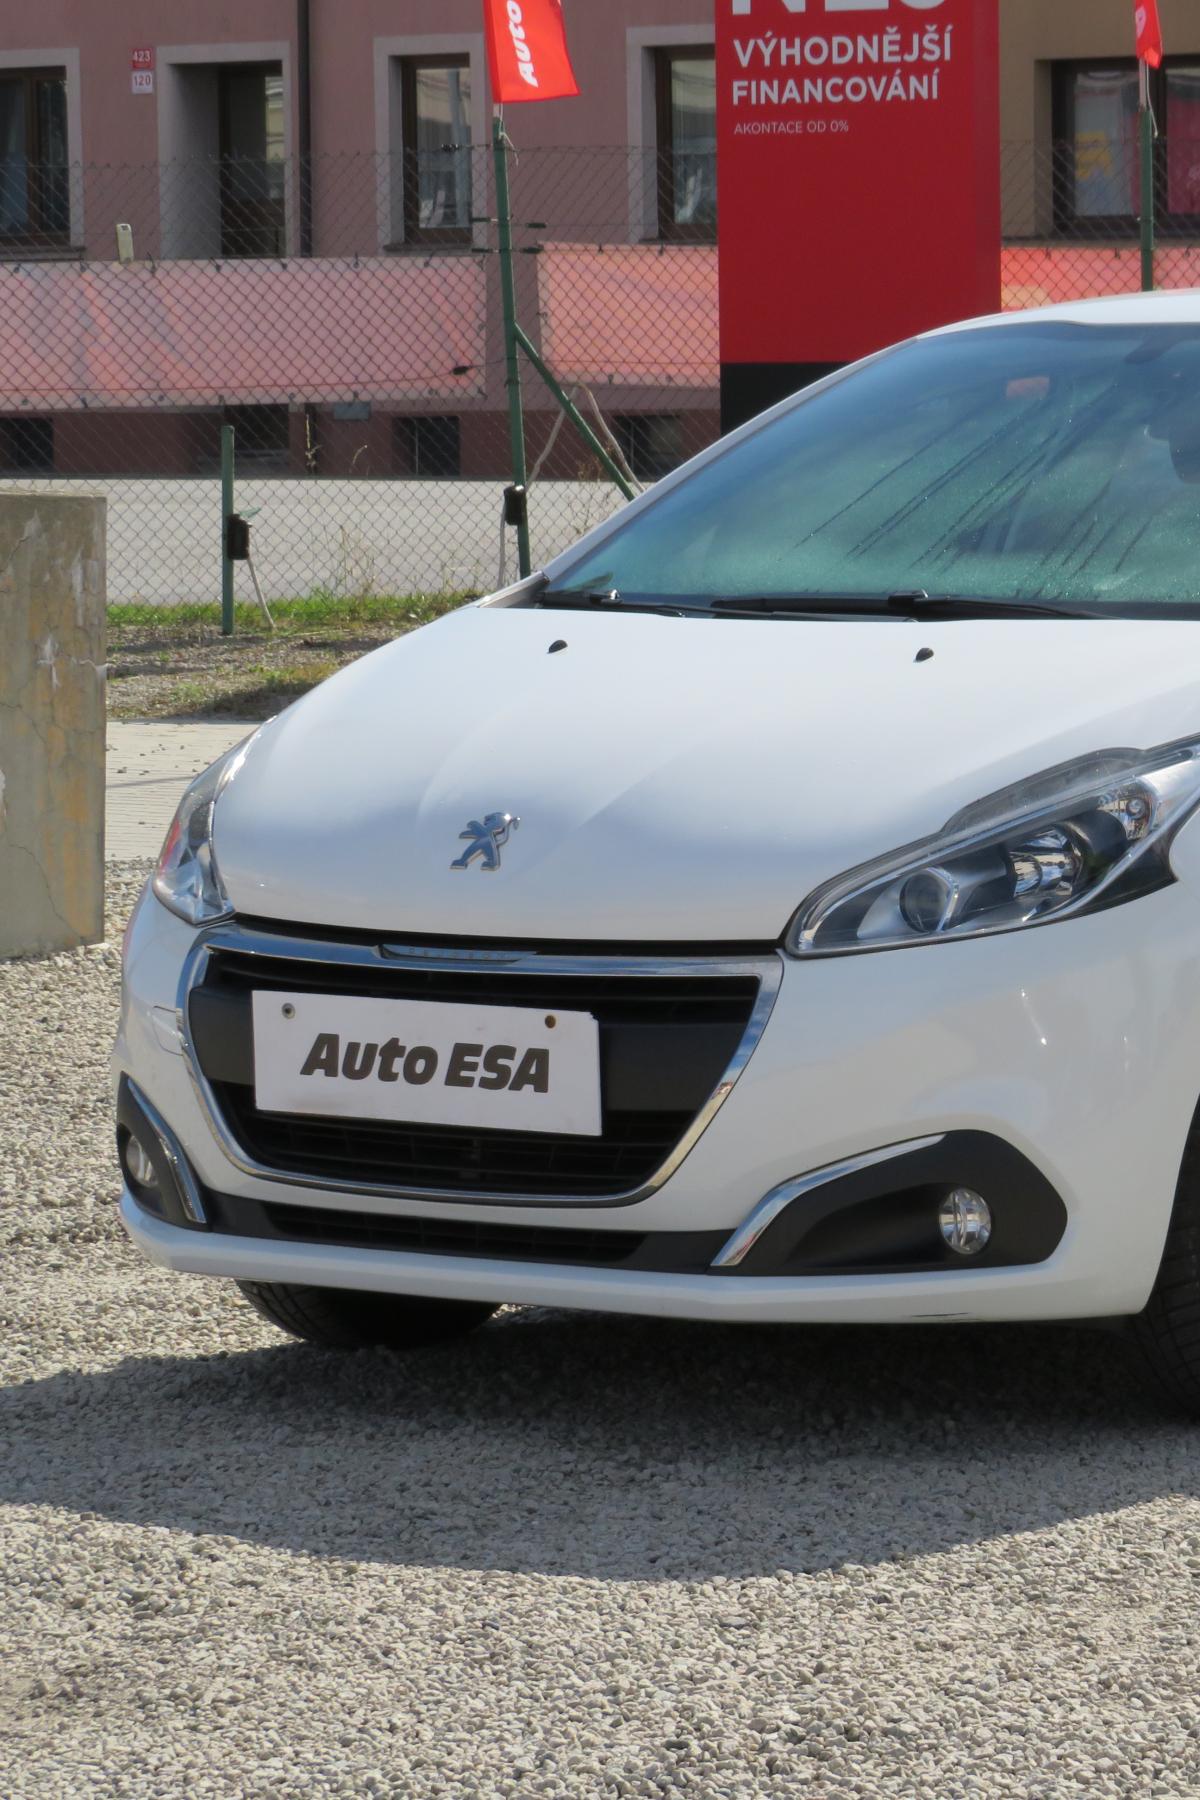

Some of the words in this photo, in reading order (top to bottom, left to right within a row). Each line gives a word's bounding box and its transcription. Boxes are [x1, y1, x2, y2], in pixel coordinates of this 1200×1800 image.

[733, 24, 953, 67] VÝHODNĚJŠÍ
[134, 75, 151, 86] 120
[732, 68, 939, 106] FINANCOVÁNÍ
[734, 121, 803, 135] AKONTACE
[807, 120, 826, 133] OD
[830, 119, 849, 133] 0%
[300, 1033, 438, 1085] Auto
[444, 1042, 550, 1093] ESA
